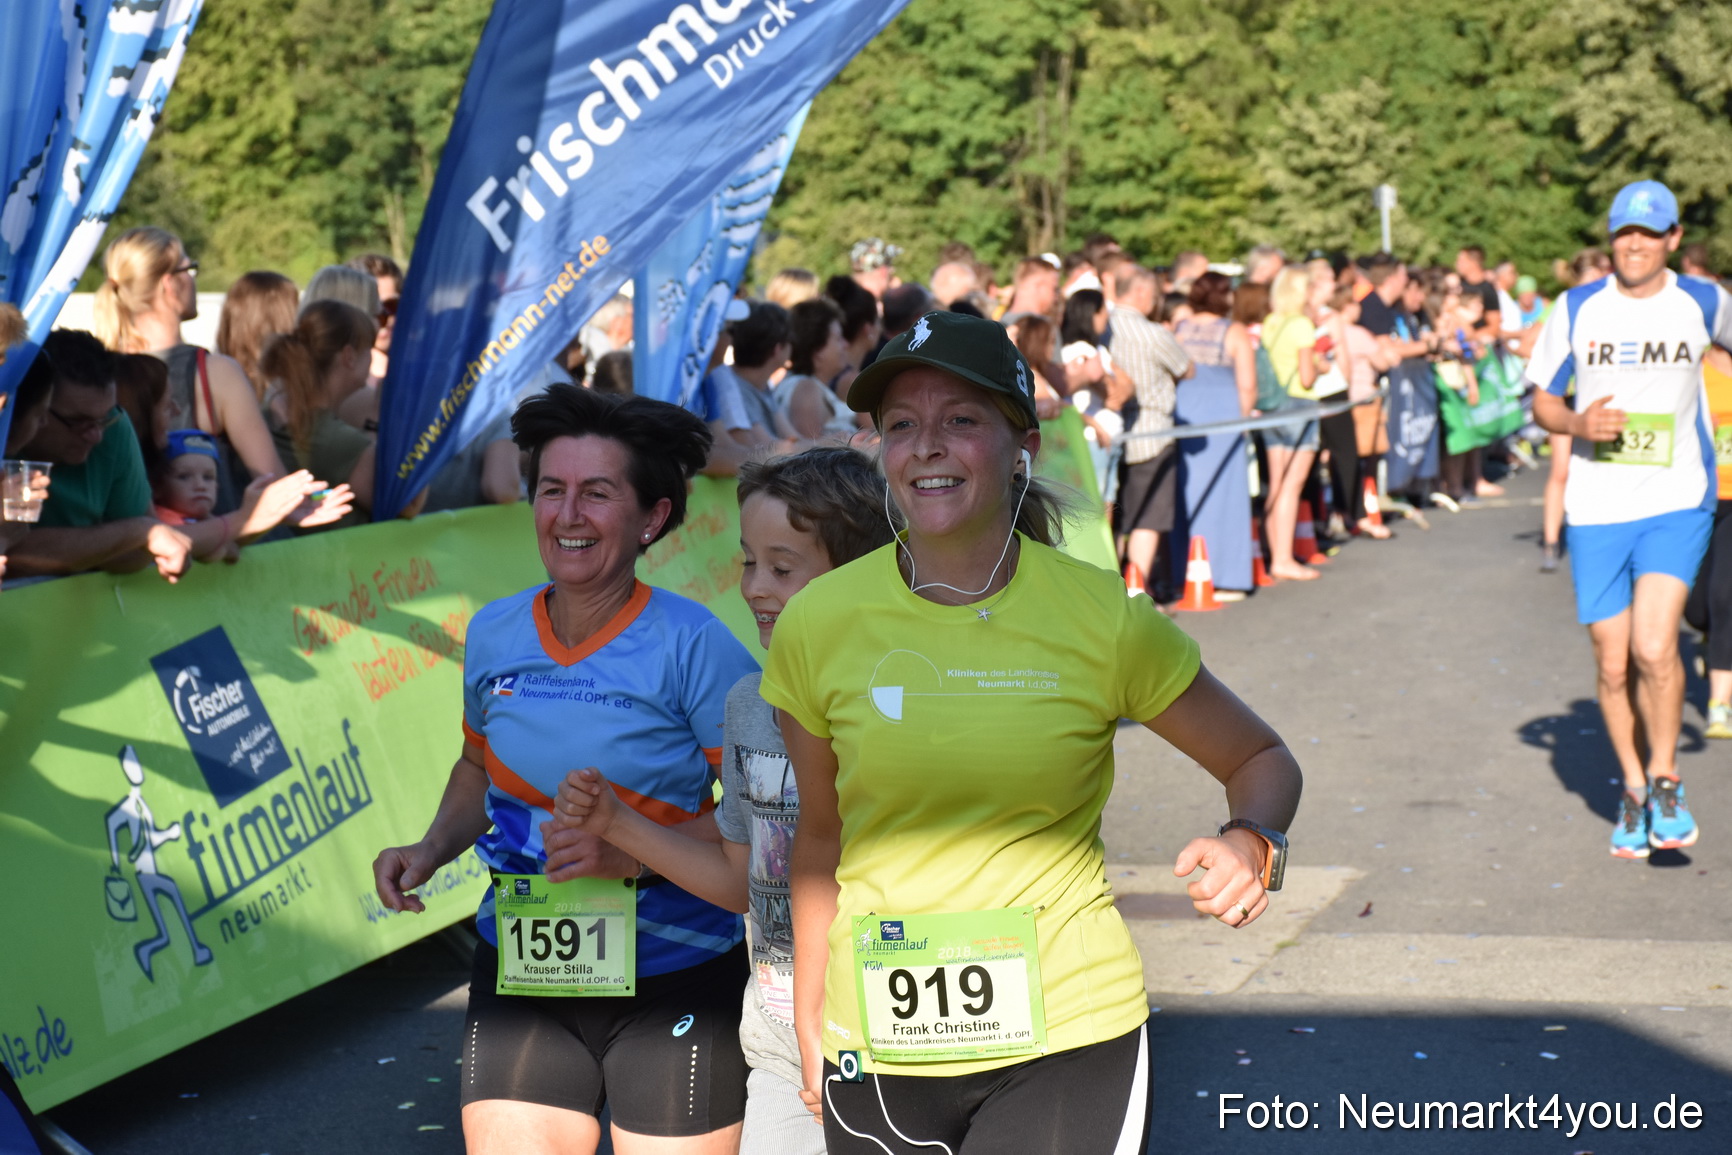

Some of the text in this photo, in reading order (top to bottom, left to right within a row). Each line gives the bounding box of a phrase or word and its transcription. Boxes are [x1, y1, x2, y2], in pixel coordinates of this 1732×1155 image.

[702, 0, 796, 90] Druck
[396, 234, 612, 479] www.frischmann-net.de
[947, 668, 1060, 680] Kliniken des Landkreises
[977, 679, 1026, 688] Neumarkt
[187, 679, 245, 725] Fischer
[519, 687, 568, 700] Neumarkt
[614, 697, 633, 710] eG
[206, 703, 252, 738] AUTOMOBILE
[182, 717, 373, 908] firmenlauf
[219, 861, 313, 944] neumarkt
[508, 893, 549, 904] firmenlauf
[554, 902, 582, 913] 2018
[510, 917, 606, 962] 1591
[872, 937, 929, 950] firmenlauf
[937, 946, 972, 960] 2018
[524, 963, 593, 975] Krauser Stilla
[504, 975, 544, 985] Raiffeisenbank
[545, 976, 580, 985] Neumarkt
[613, 976, 625, 984] eG
[888, 964, 994, 1020] 919
[892, 1020, 1001, 1036] Frank Christine
[871, 1037, 895, 1046] Kliniken
[897, 1037, 909, 1045] des
[910, 1036, 956, 1046] Landkreises
[957, 1034, 997, 1044] Neumarkt
